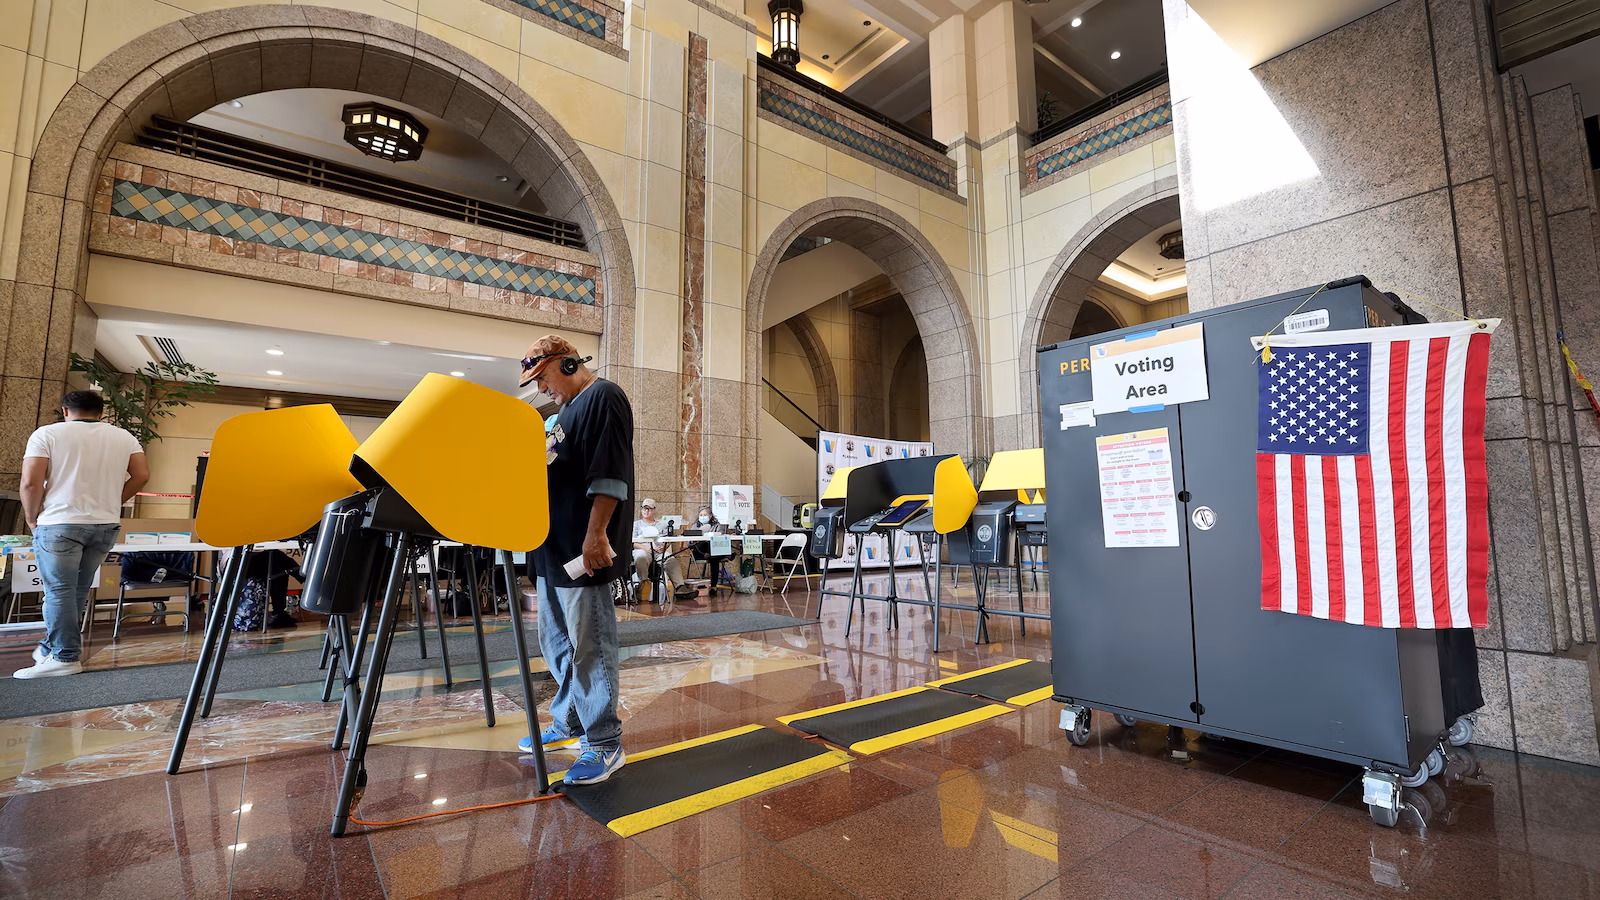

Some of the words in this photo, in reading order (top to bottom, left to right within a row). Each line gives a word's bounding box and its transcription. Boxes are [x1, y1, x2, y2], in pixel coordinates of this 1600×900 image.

[1060, 358, 1090, 375] PER
[1114, 356, 1174, 376] Voting
[1125, 383, 1168, 400] Area
